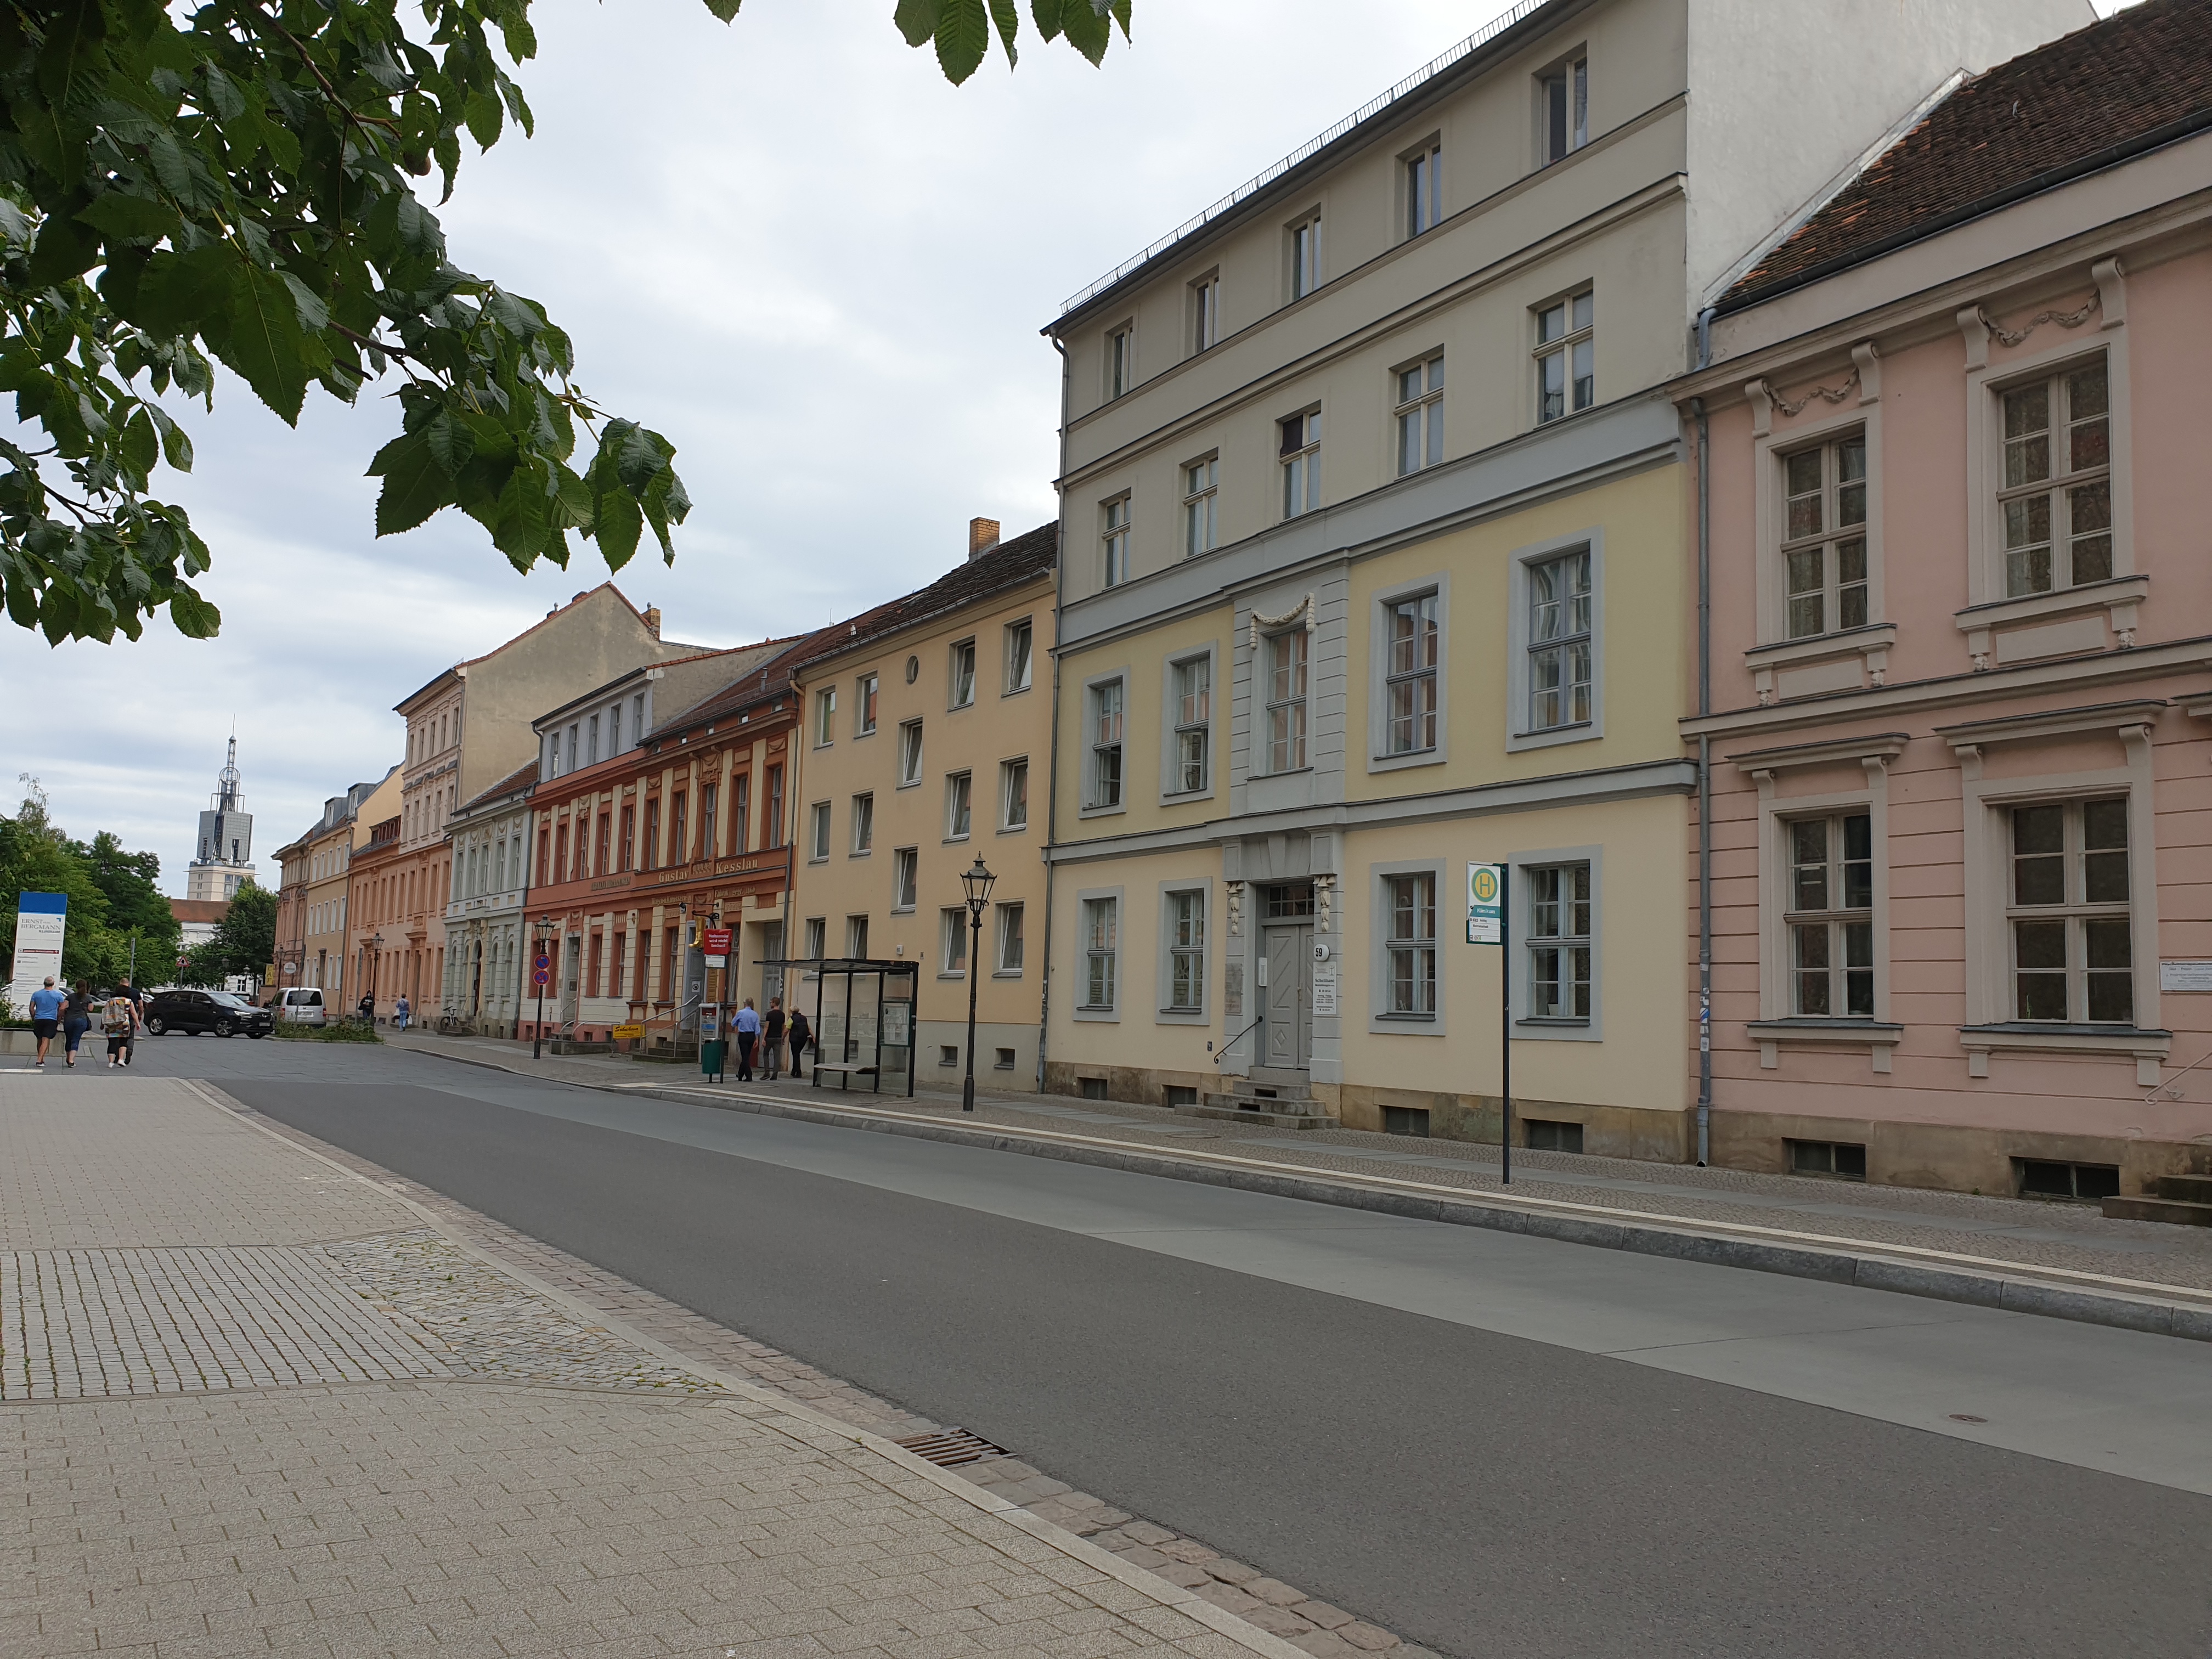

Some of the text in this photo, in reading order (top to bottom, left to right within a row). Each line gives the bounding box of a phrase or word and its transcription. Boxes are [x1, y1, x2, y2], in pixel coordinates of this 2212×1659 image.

[659, 858, 758, 883] Gustav Kesslau
[1479, 875, 1490, 895] H
[1316, 948, 1322, 957] 59
